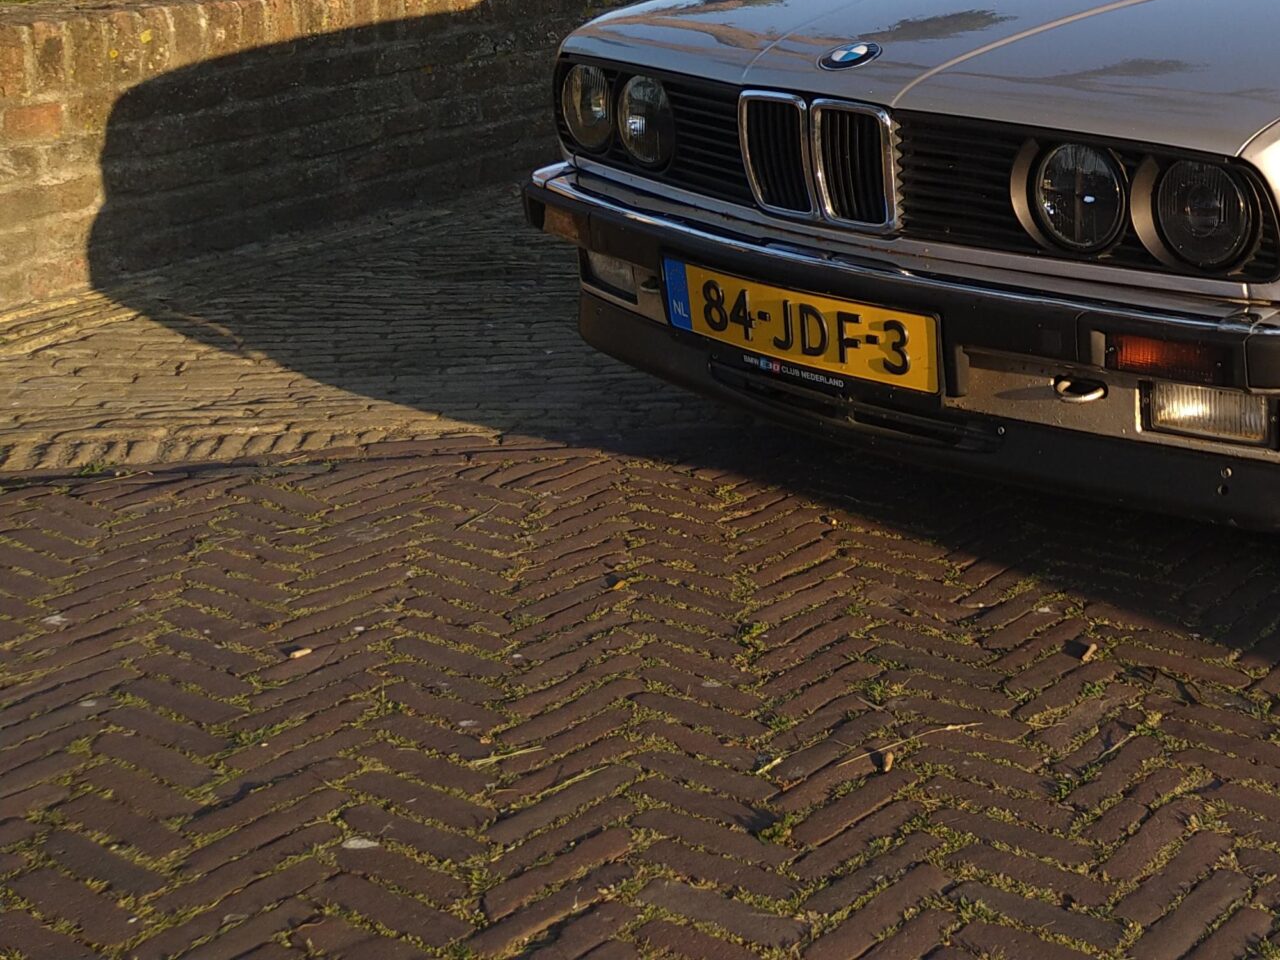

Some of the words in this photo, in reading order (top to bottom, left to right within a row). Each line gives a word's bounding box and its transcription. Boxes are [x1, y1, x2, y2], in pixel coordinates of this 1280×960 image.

[672, 298, 689, 318] NL
[702, 279, 910, 375] 84-JDF-3
[743, 354, 759, 366] BMW
[781, 365, 800, 377] CLUB
[800, 370, 845, 388] NEDERLAND
